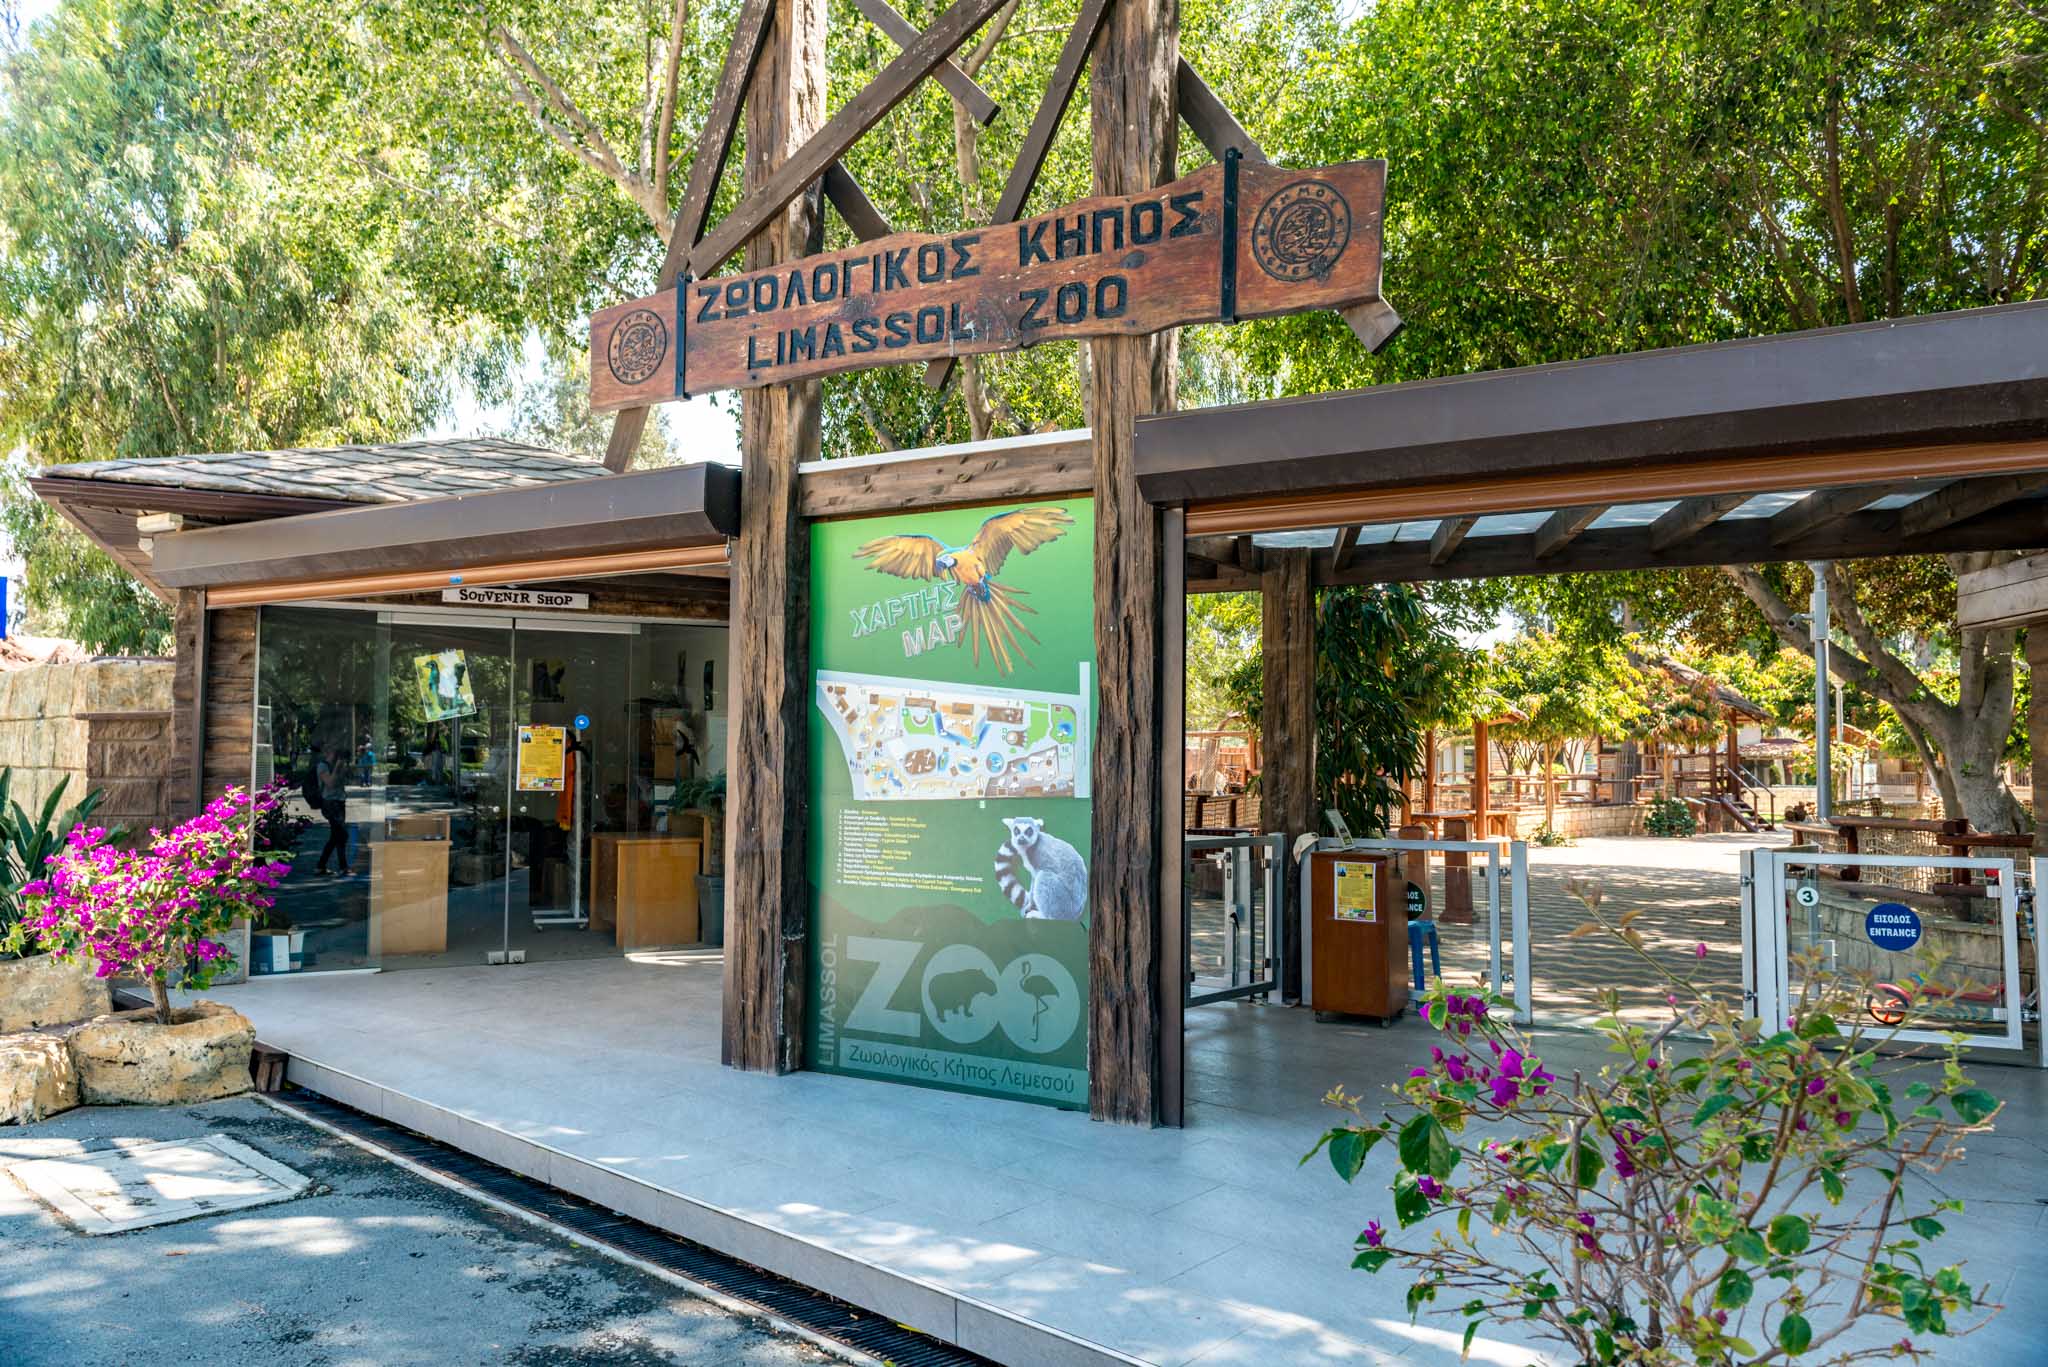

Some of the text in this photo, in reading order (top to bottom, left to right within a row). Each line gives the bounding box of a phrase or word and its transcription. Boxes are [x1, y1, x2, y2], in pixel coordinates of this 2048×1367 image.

[697, 191, 1204, 324] ΖΩΟΛΟΓΙΚΟΣ ΚΗΠΟΣ
[747, 275, 1128, 370] LIMASSOL ZOO
[459, 588, 573, 606] SOUVENIR SHOP
[849, 580, 961, 639] ΧΑΡΤΗΣ
[902, 613, 964, 657] MAP
[1802, 890, 1813, 902] 3
[1869, 927, 1918, 938] ENTRANCE
[1873, 914, 1912, 925] ΕΙΣΟΔΟΣ
[817, 934, 838, 1066] LIMASSOL
[849, 1045, 1075, 1094] Ζωολογικός Κήπος Λεμεσού
